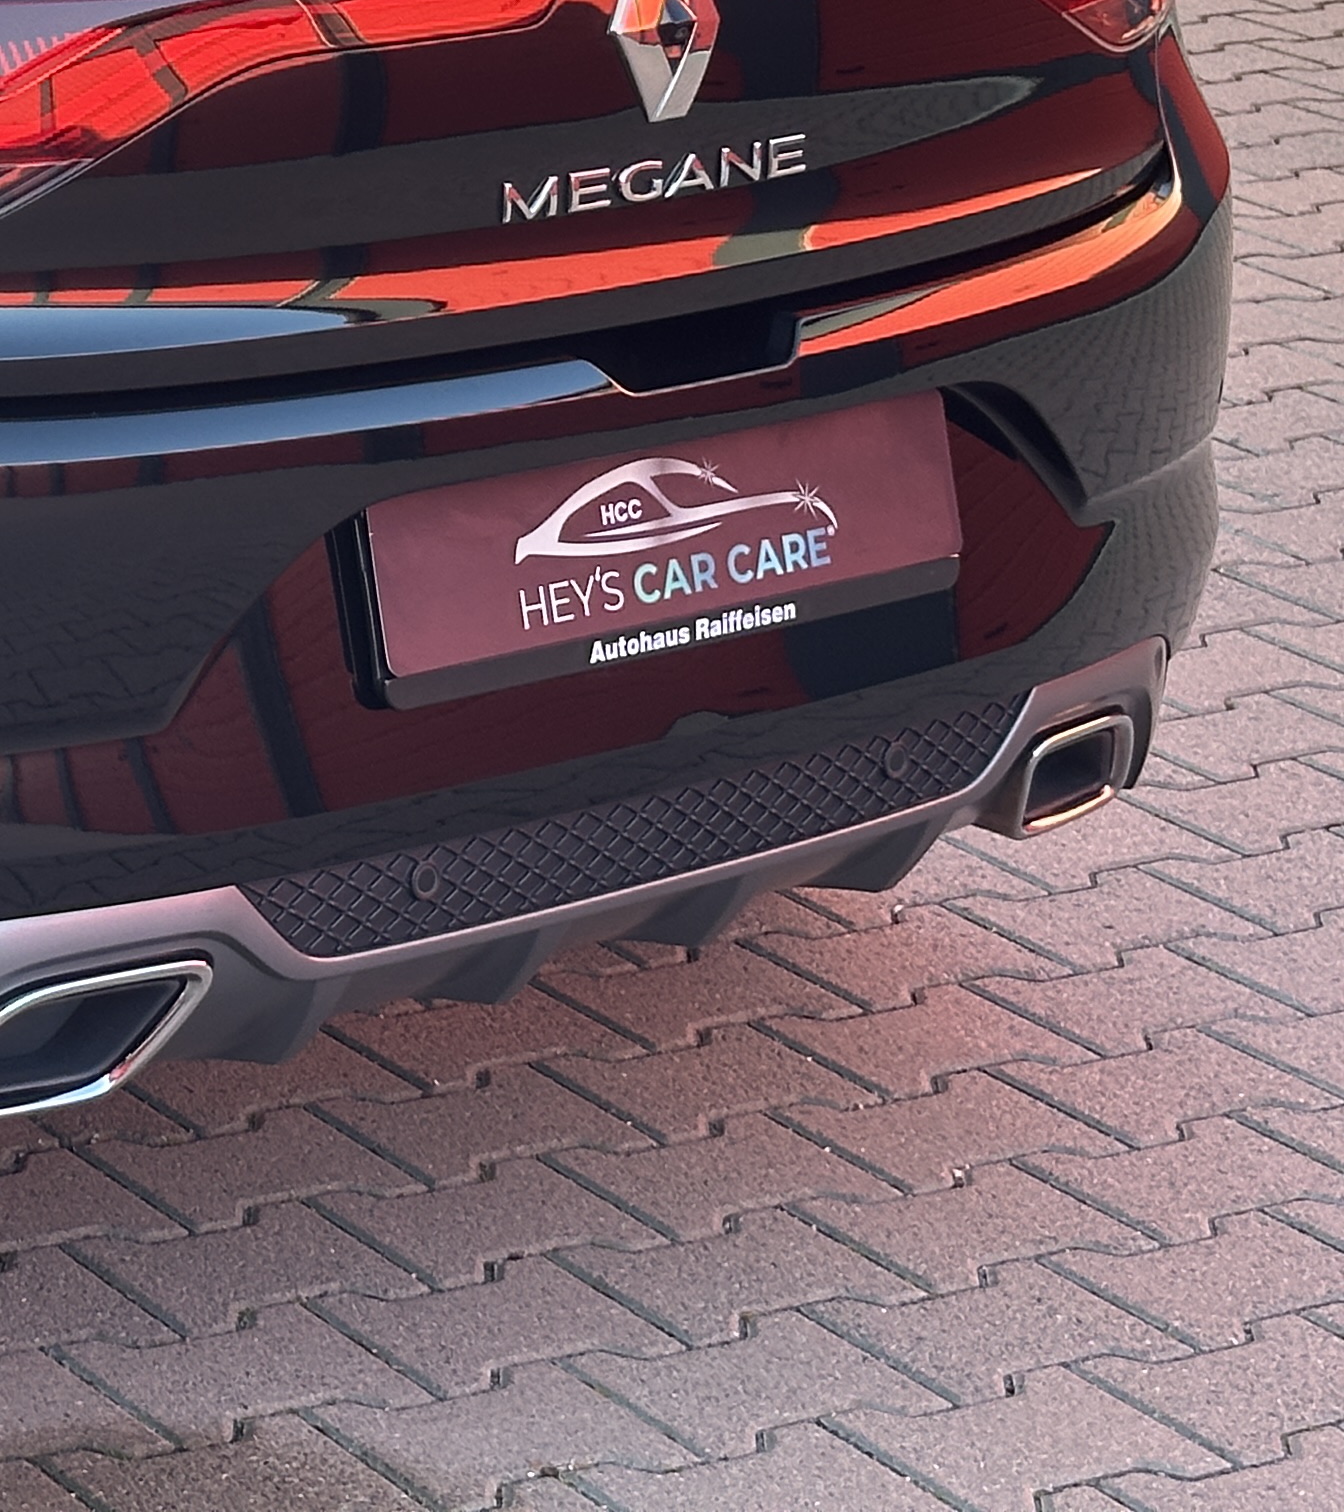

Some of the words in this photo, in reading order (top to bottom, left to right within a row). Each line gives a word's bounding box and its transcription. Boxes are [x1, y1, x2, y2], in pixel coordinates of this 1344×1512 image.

[502, 134, 806, 224] MEGANE
[600, 499, 643, 526] HCC
[519, 566, 625, 630] HEY'S
[634, 552, 719, 604] CAR
[590, 625, 691, 665] Autohaus
[695, 601, 797, 642] Raiffeisen
